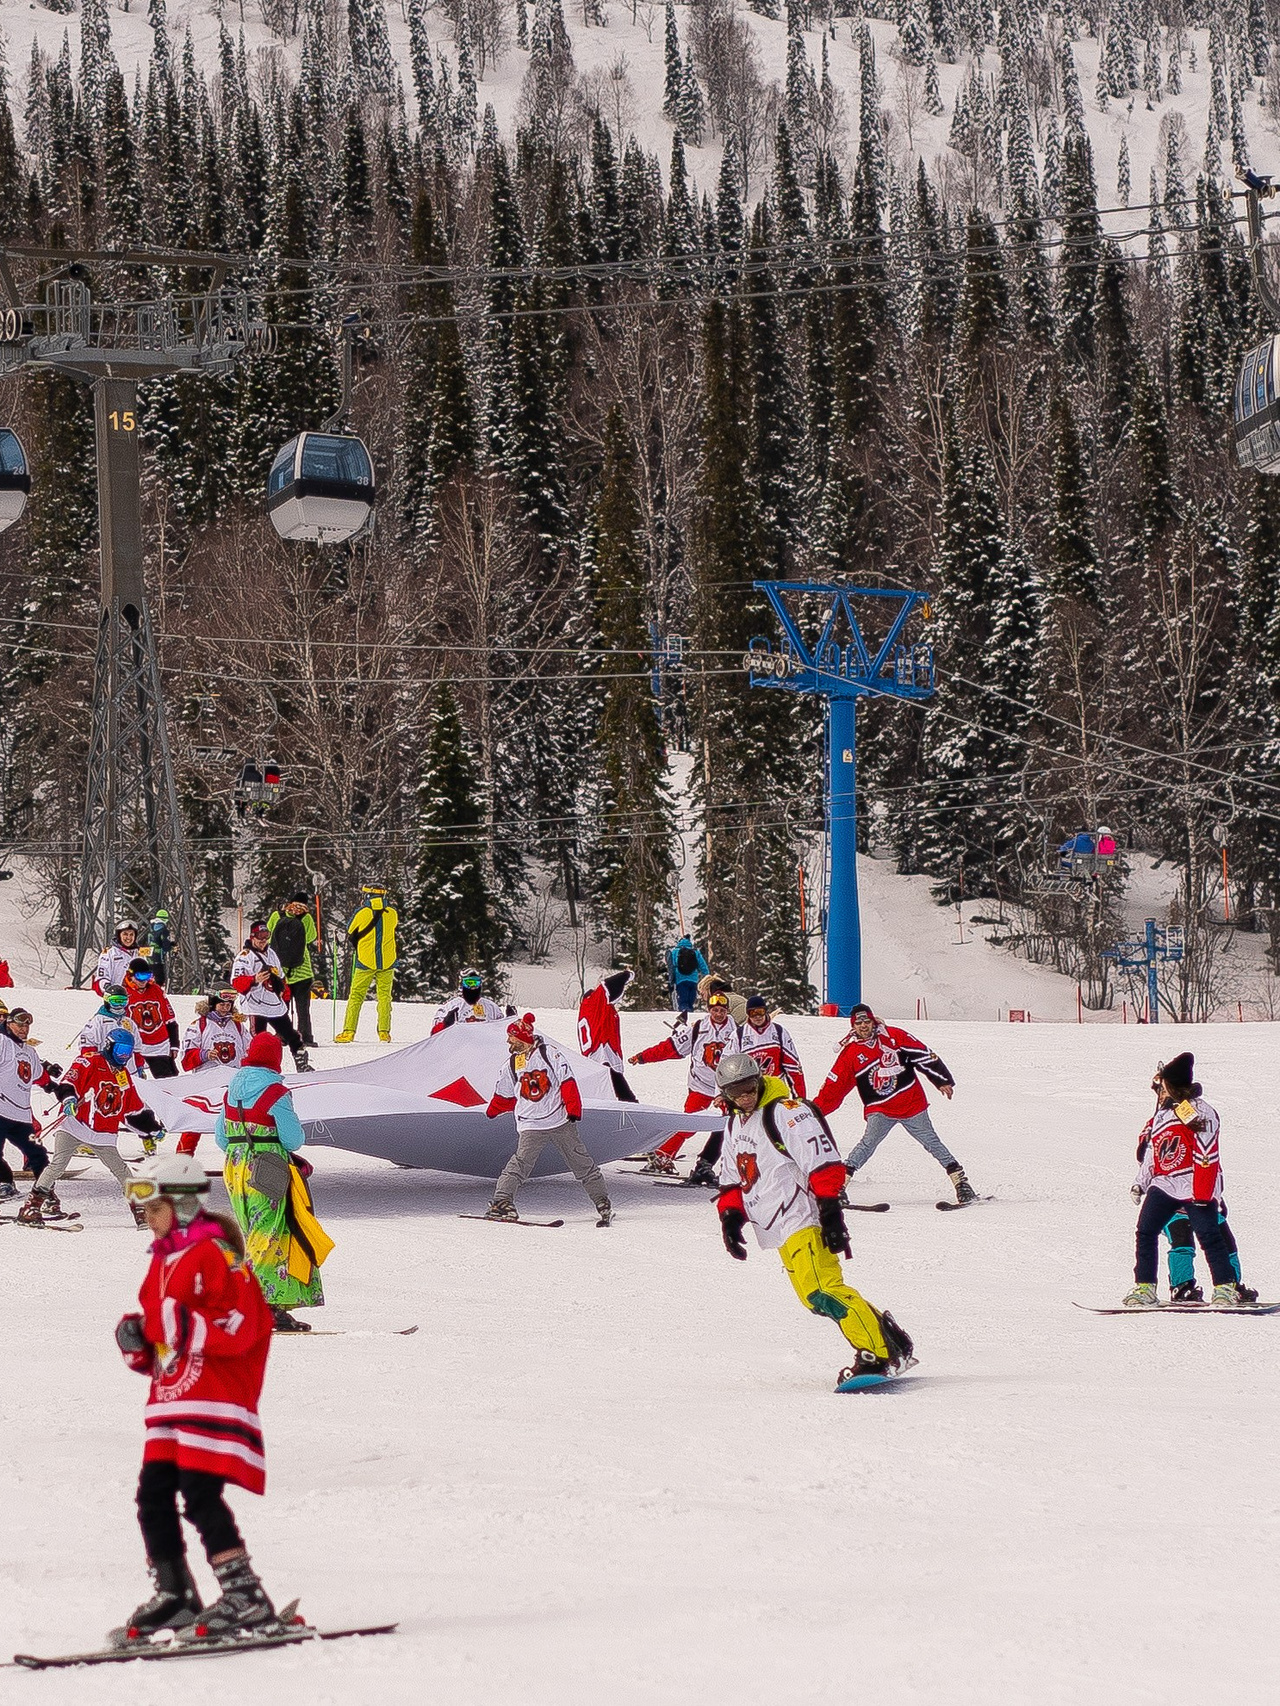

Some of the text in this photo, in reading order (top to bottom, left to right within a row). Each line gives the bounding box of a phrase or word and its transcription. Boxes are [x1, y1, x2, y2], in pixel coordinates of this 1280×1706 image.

[108, 410, 136, 431] 15
[356, 475, 369, 486] 38
[806, 1133, 833, 1156] 75
